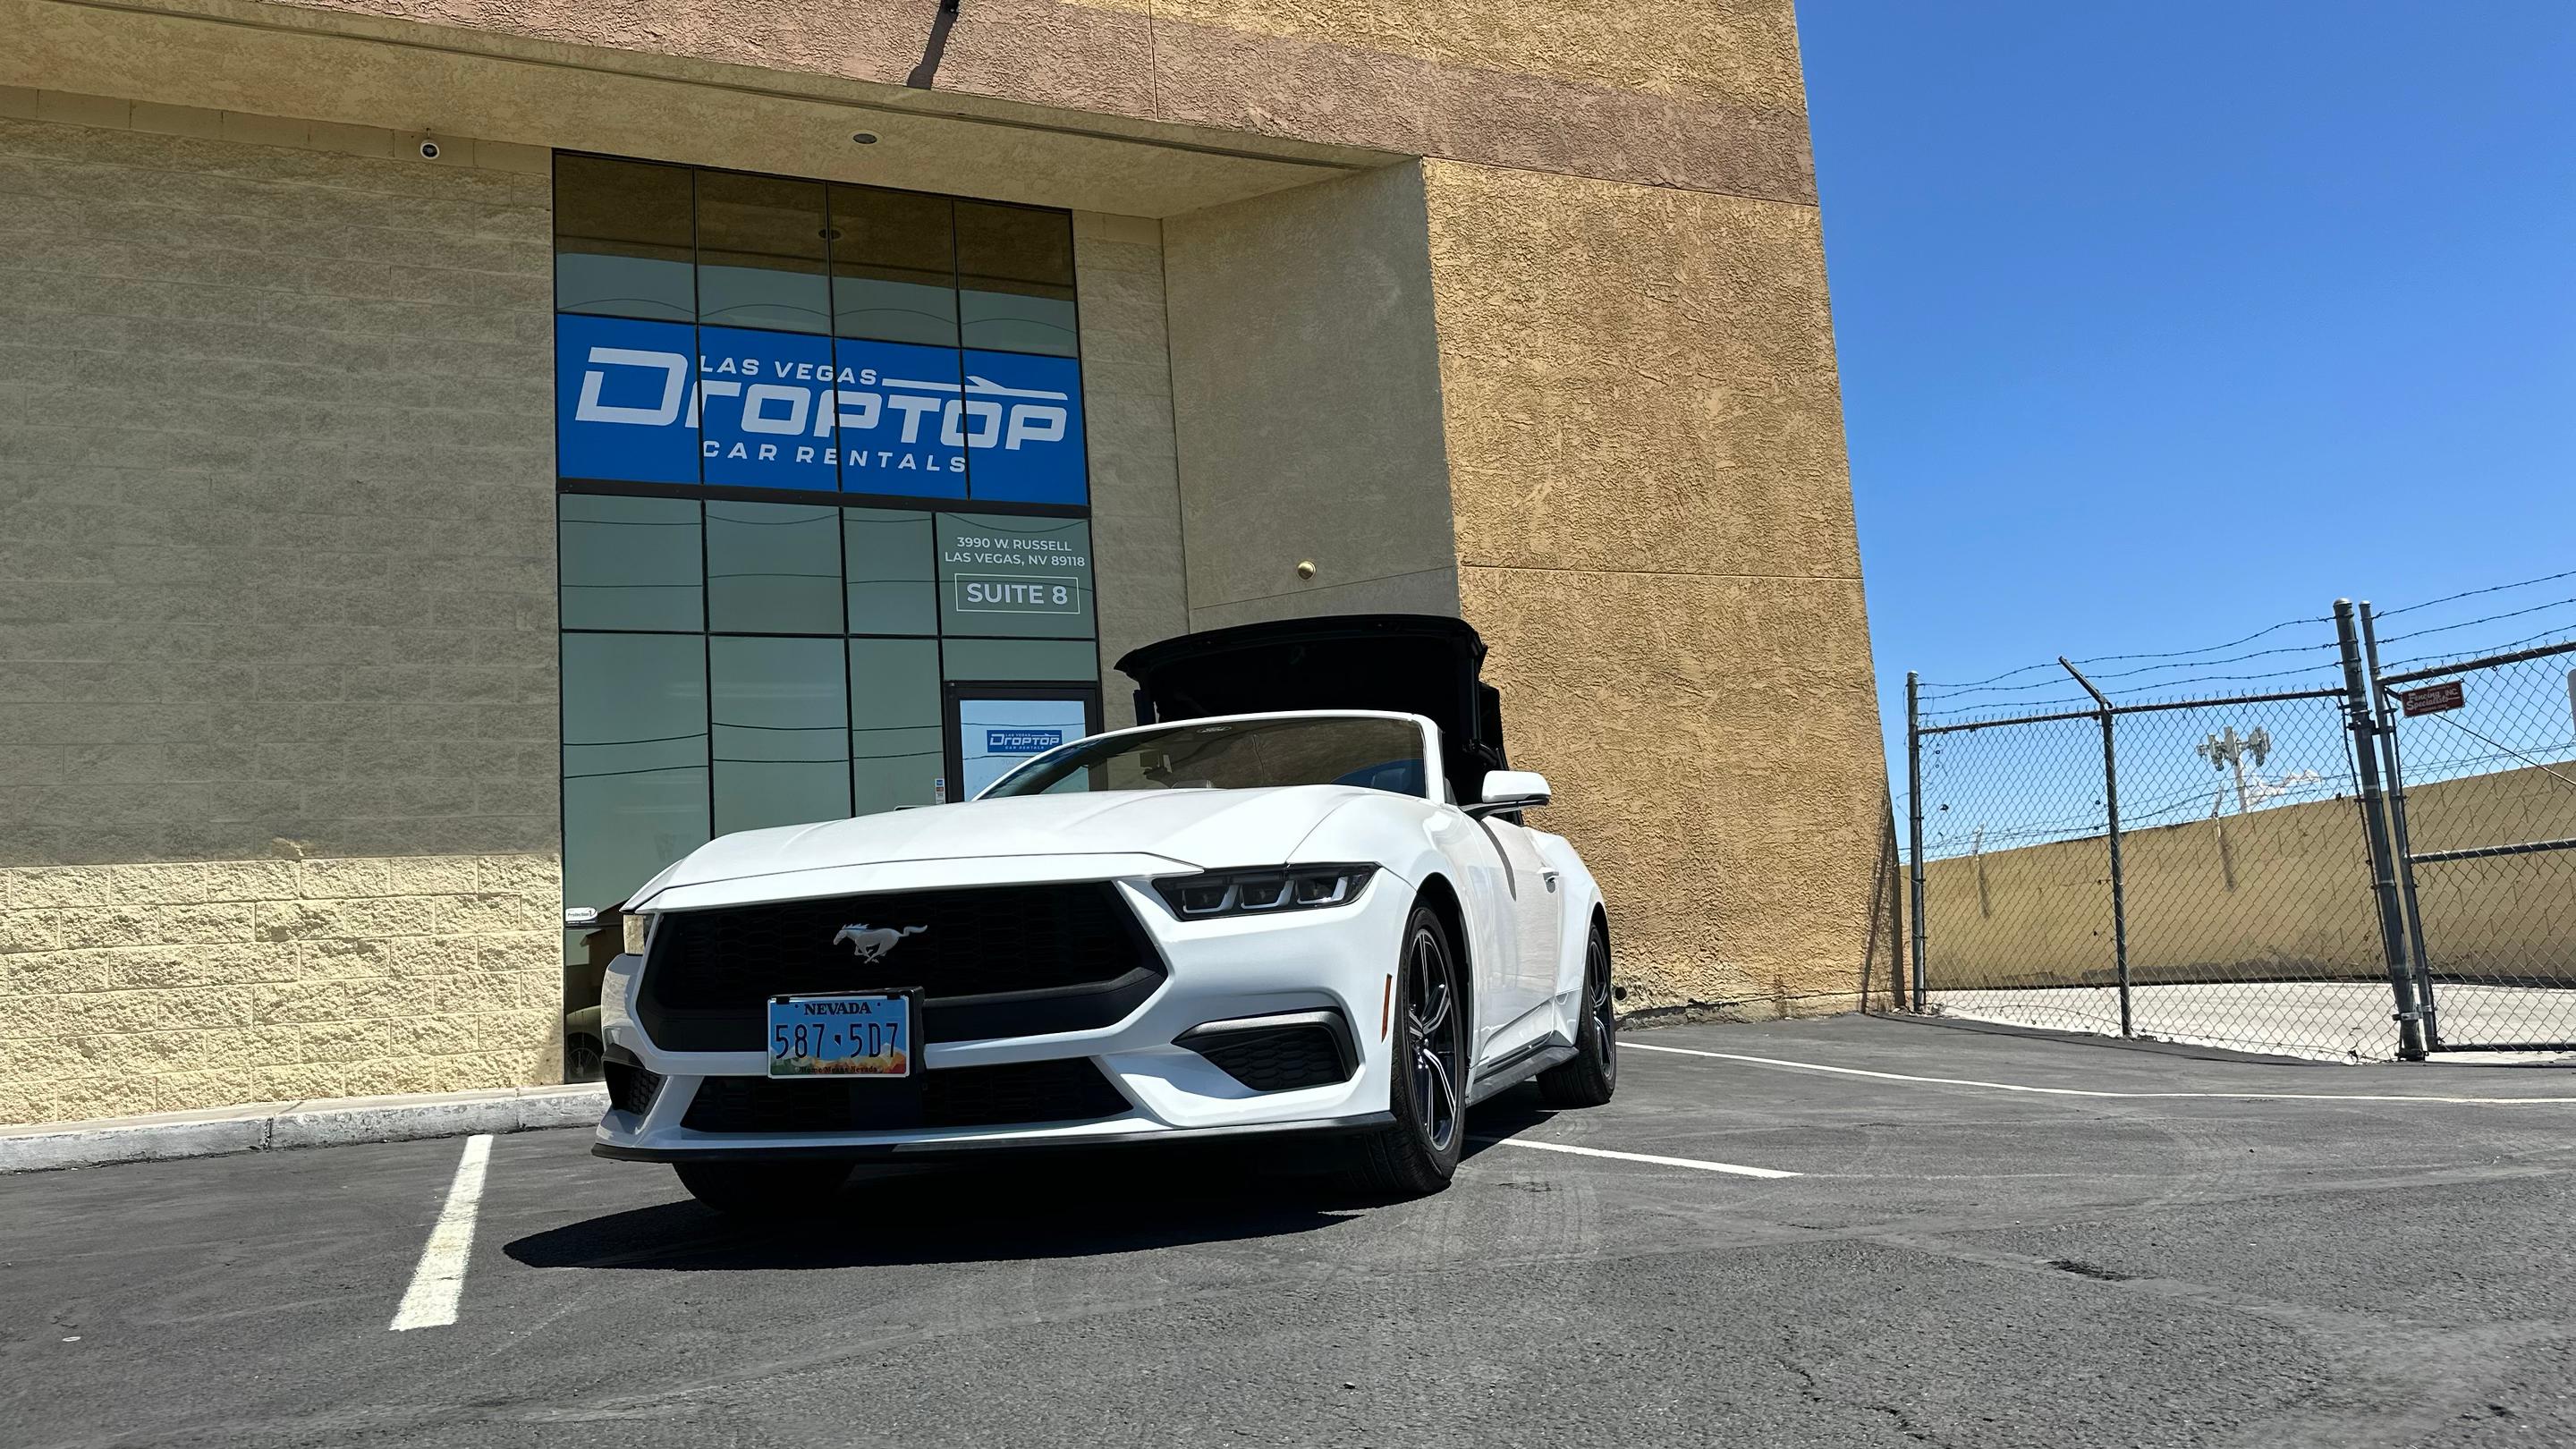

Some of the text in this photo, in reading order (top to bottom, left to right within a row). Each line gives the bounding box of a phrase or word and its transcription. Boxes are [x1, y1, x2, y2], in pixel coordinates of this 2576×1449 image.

[700, 355, 877, 386] LAS VEGAS
[702, 440, 967, 473] CAR RENTALS
[957, 537, 990, 548] 3990
[1013, 539, 1072, 551] RUSSELL
[945, 552, 1085, 567] LAS VEGAS, NV 89118
[967, 582, 1068, 605] SUITE 8
[805, 1002, 872, 1015] NEVADA
[775, 1022, 898, 1059] 587 5D7
